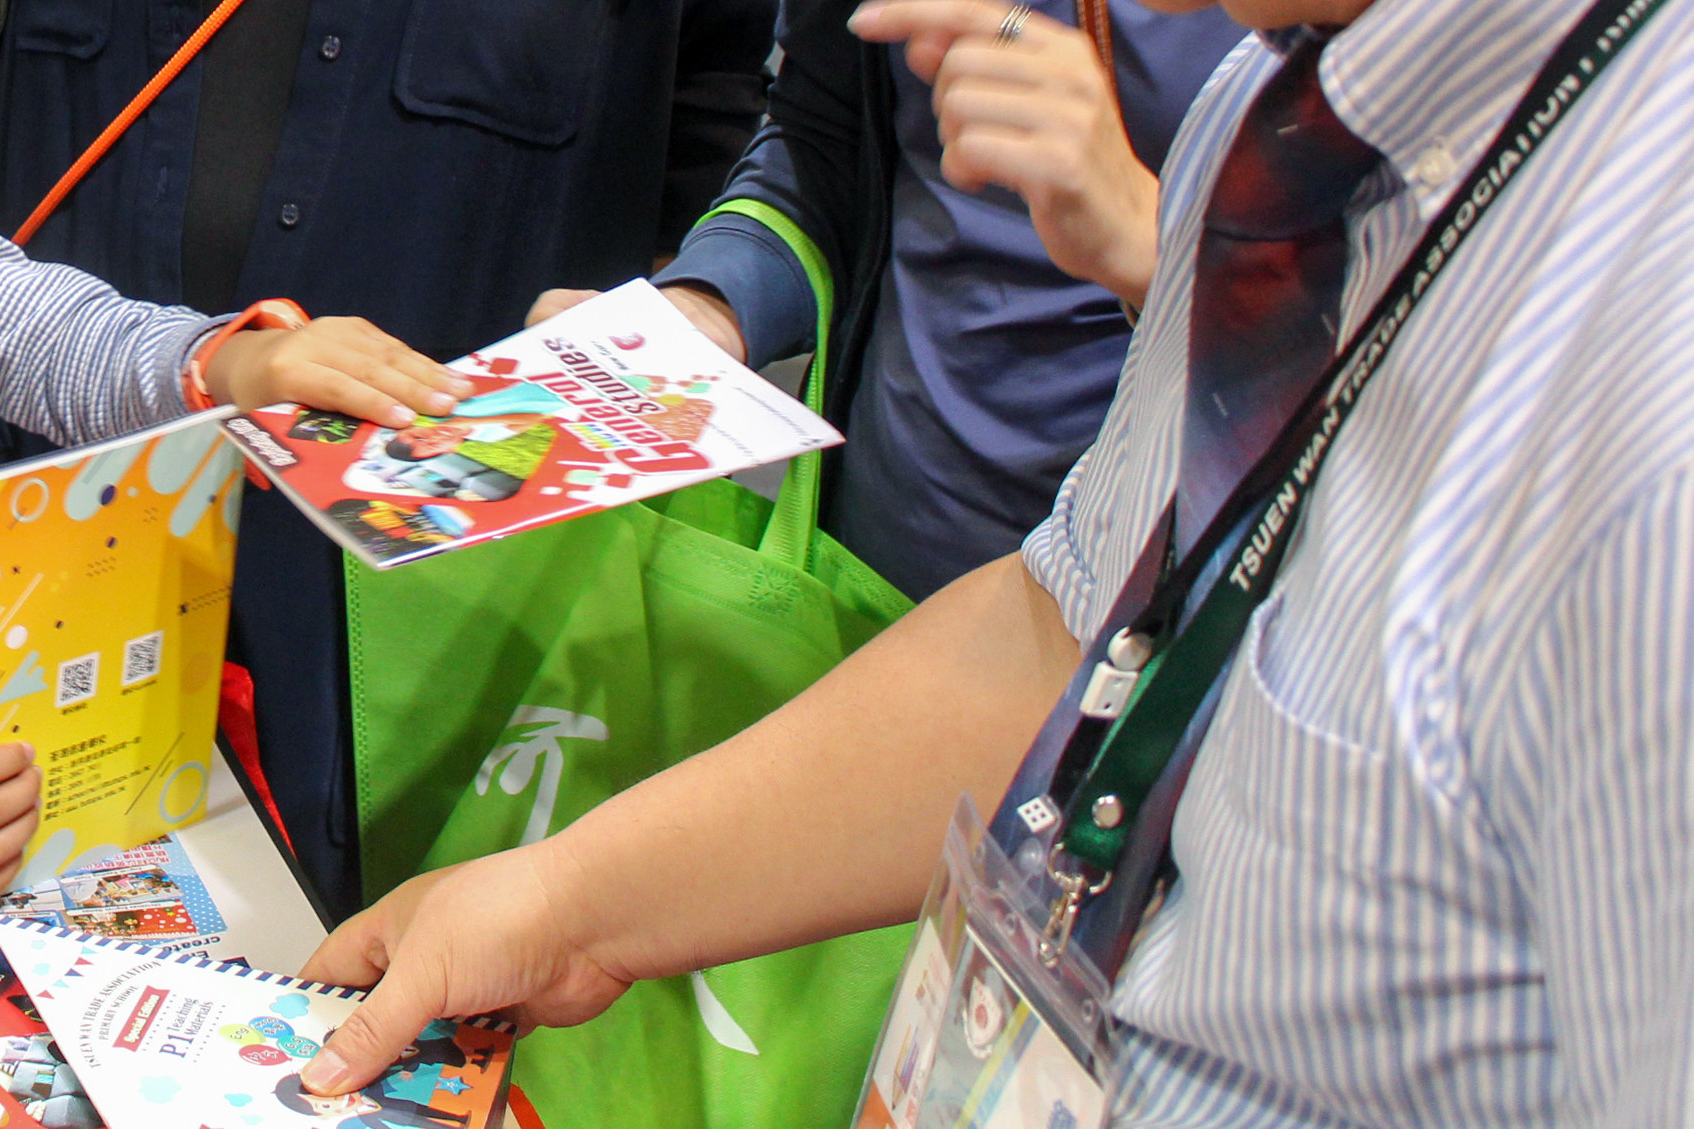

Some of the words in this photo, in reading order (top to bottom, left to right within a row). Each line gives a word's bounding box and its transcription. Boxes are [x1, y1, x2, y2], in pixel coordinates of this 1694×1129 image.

[542, 336, 661, 415] Studies
[525, 371, 711, 474] General
[1229, 481, 1299, 592] TSUEN
[1293, 404, 1341, 485] WAN
[1342, 293, 1413, 405] TRADE
[163, 936, 221, 954] create
[99, 1008, 118, 1041] PRIMARY
[111, 984, 139, 1008] SCHOOL
[166, 996, 199, 1032] Teaching
[184, 1000, 214, 1036] Materials
[159, 1034, 195, 1059] P1
